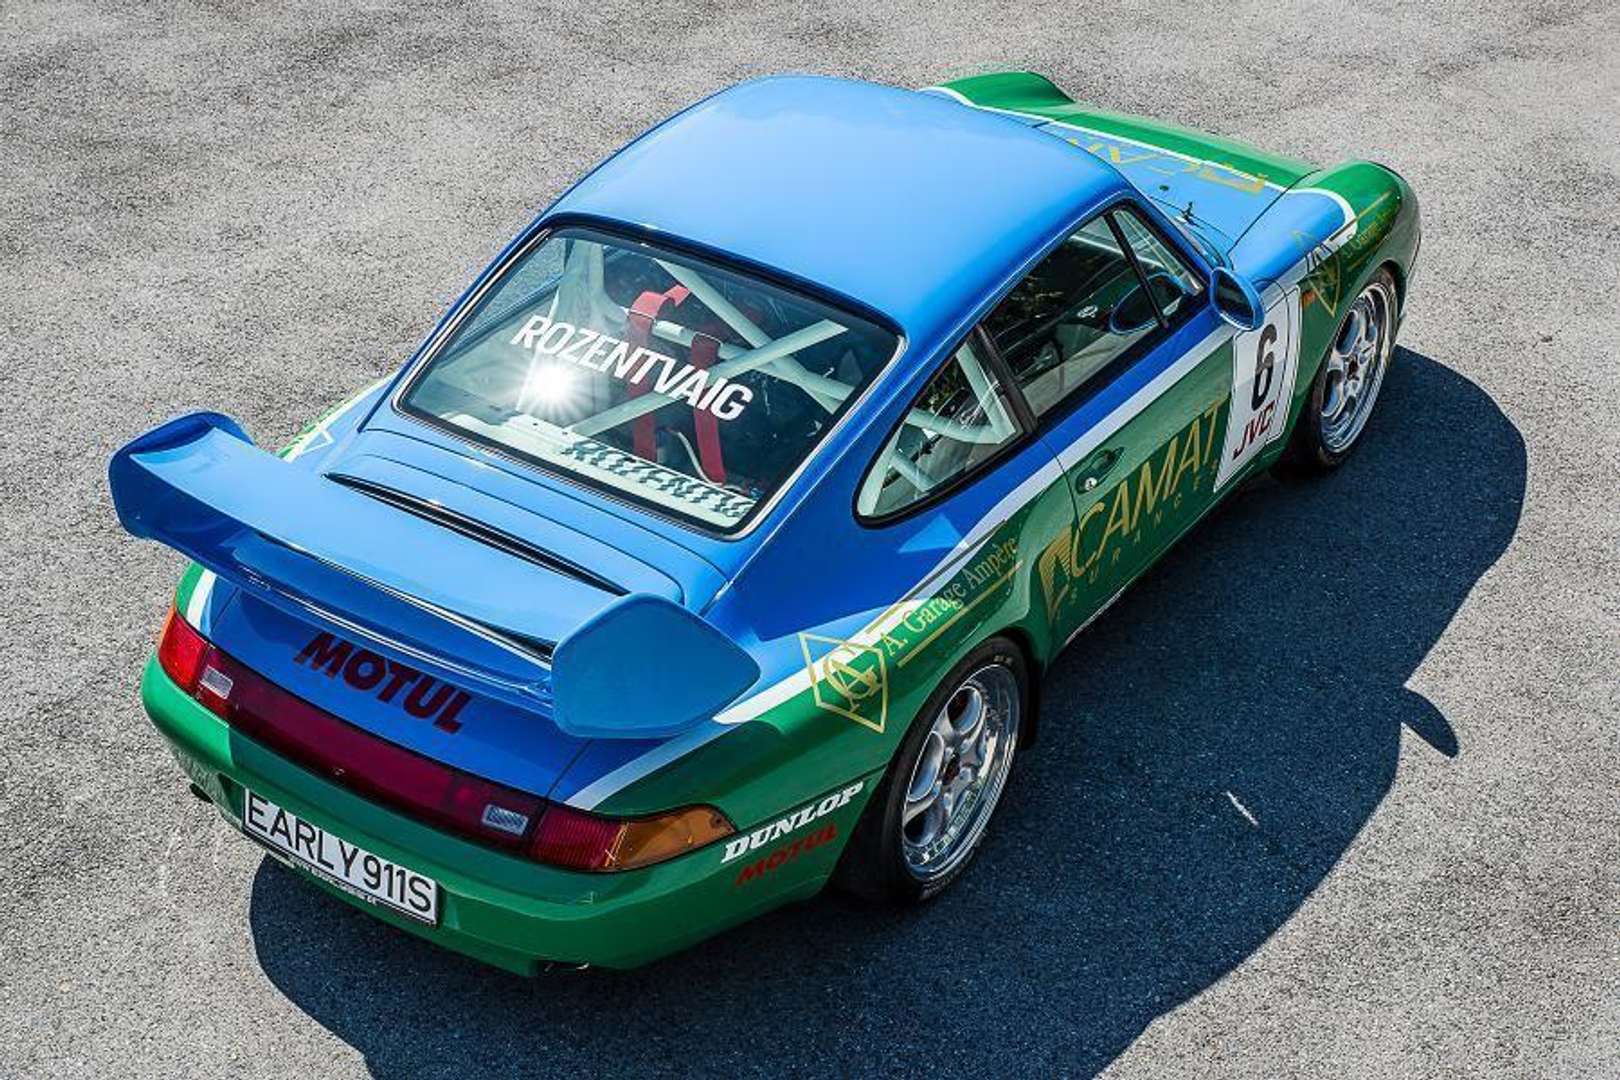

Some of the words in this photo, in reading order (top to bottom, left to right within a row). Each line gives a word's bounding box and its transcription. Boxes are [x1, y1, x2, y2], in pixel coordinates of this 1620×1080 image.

[511, 315, 753, 421] ROZENTVAIG
[1251, 323, 1278, 411] 6
[1232, 399, 1276, 460] JVC
[1071, 398, 1226, 578] CAMAT
[880, 631, 909, 656] A.
[902, 582, 967, 633] Garage
[294, 632, 475, 733] MOTUL
[720, 780, 864, 865] DUNLOP
[735, 822, 838, 887] MOTUL
